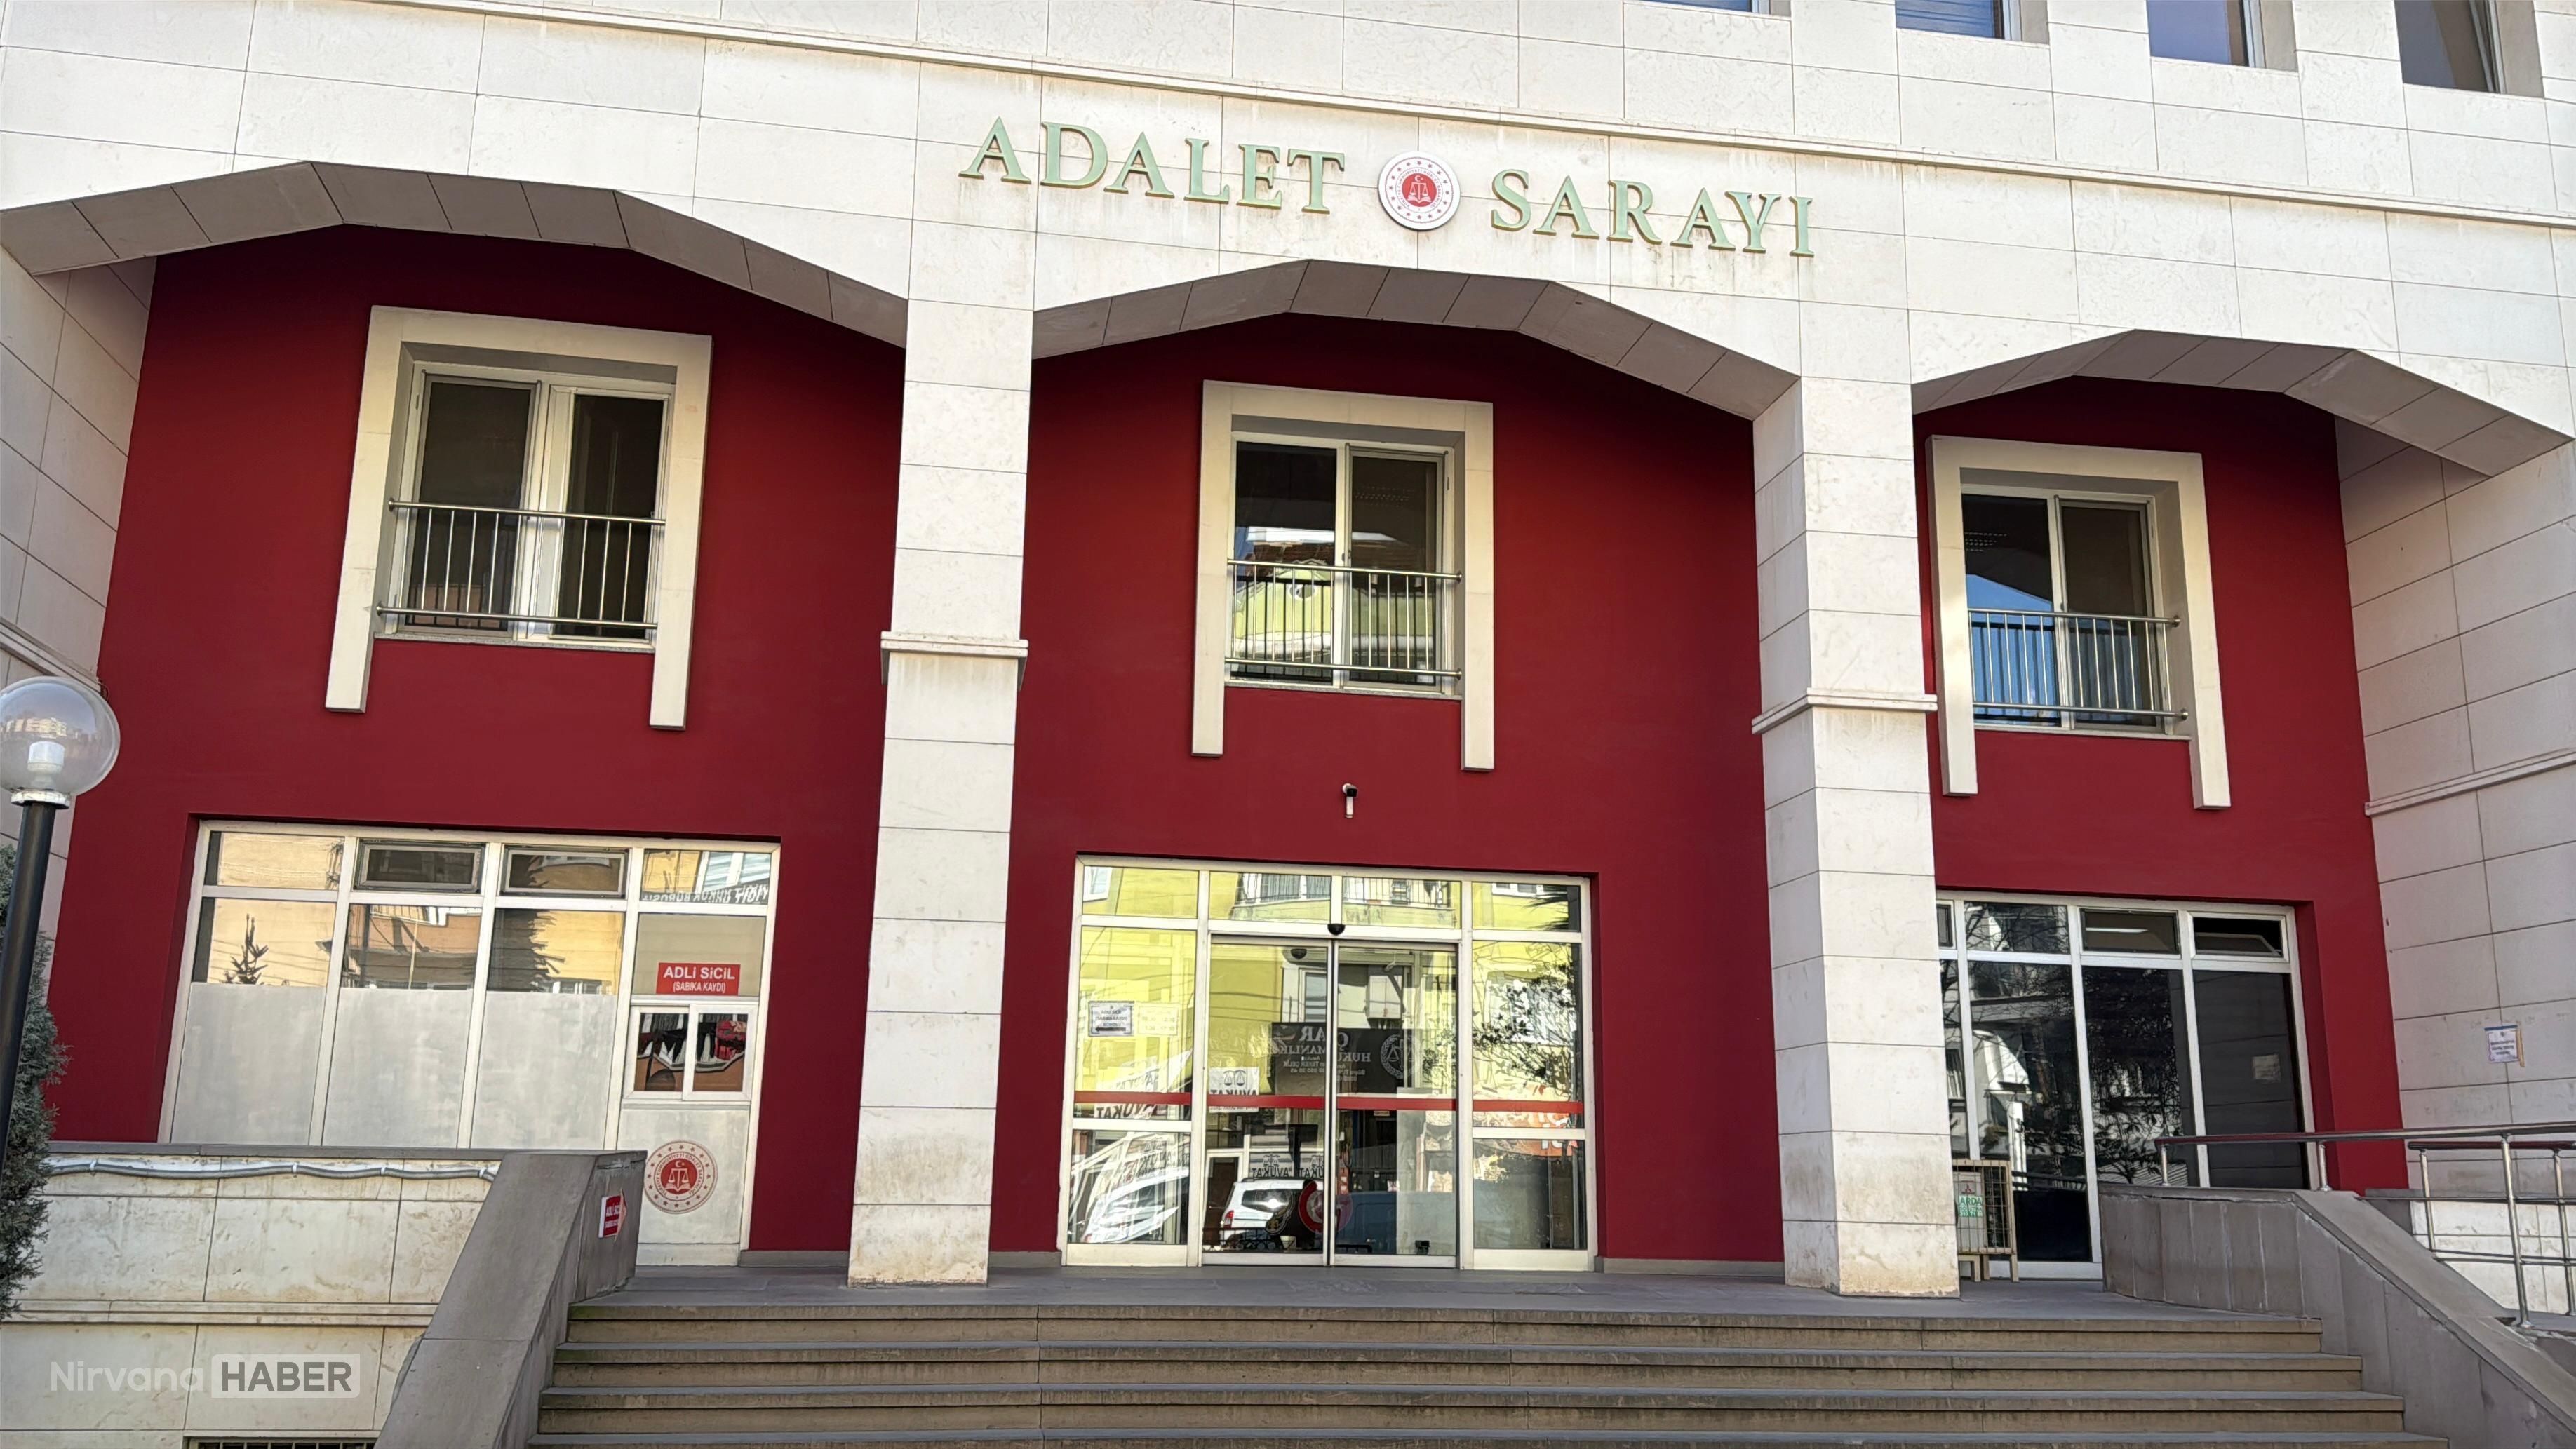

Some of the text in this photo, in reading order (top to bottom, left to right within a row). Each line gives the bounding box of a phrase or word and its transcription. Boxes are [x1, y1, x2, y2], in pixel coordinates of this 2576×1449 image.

[958, 116, 1815, 257] ADALET SARAYI
[673, 982, 726, 993] (SABIKA KAYDI)
